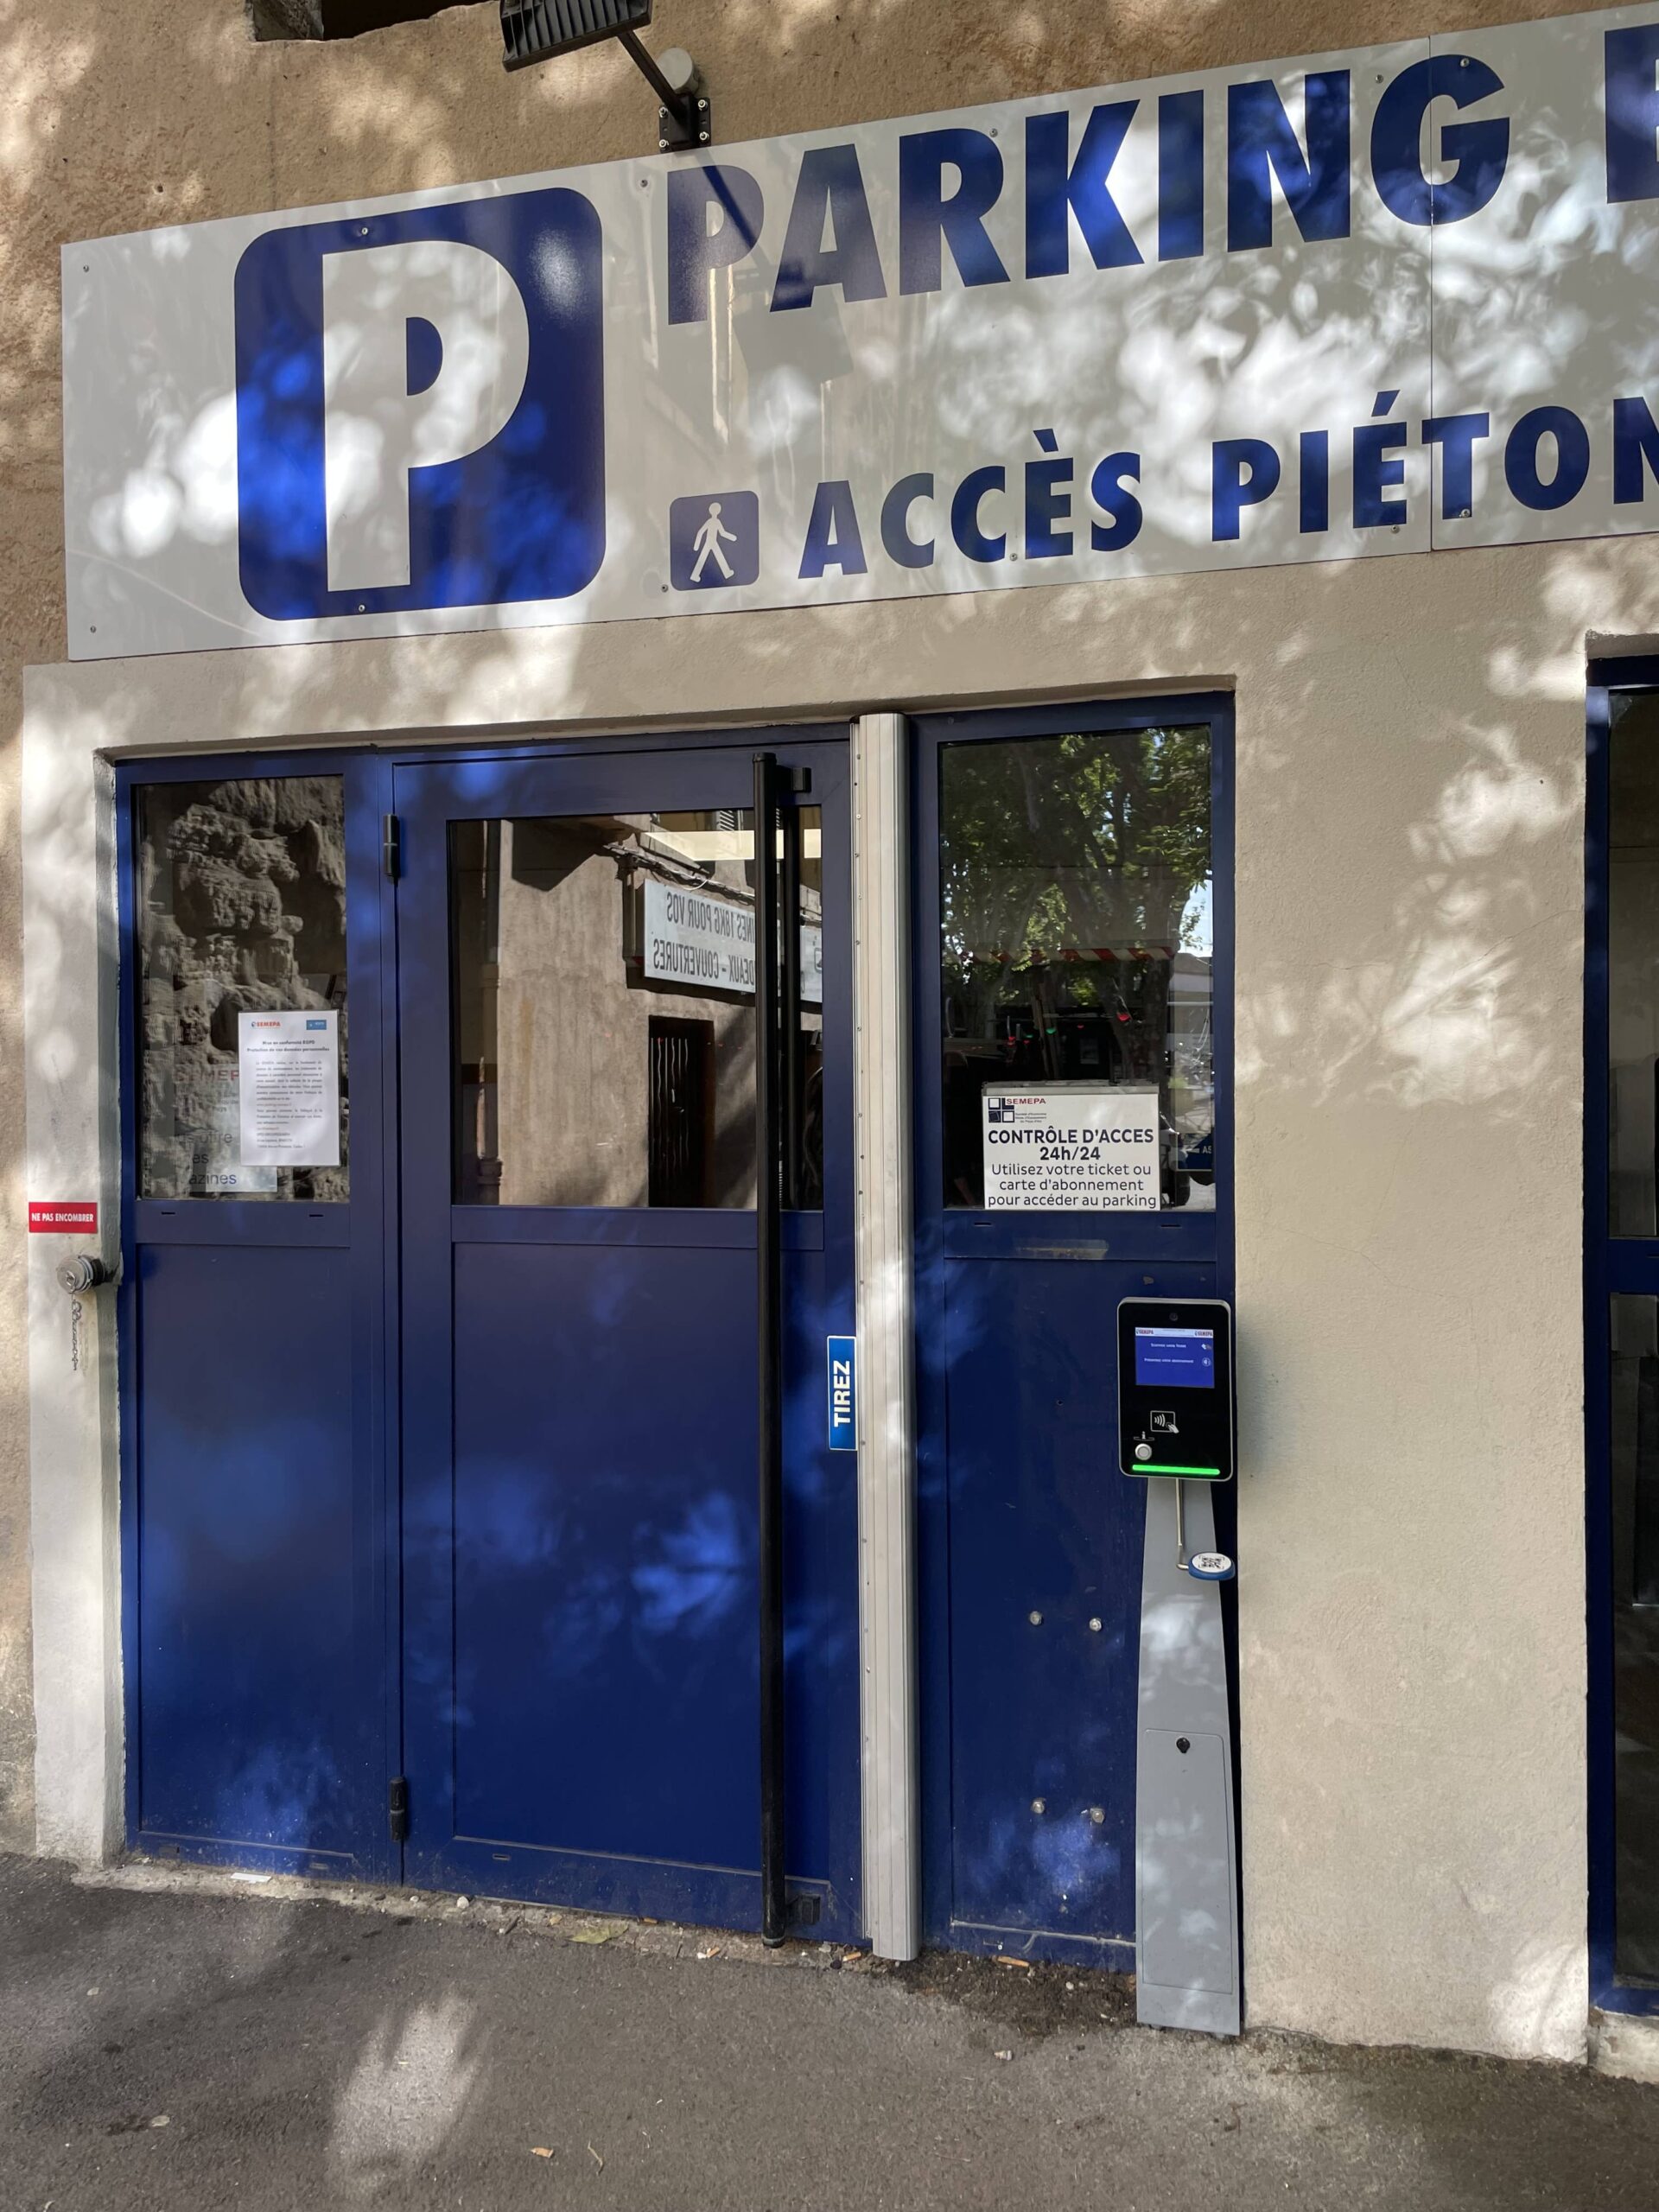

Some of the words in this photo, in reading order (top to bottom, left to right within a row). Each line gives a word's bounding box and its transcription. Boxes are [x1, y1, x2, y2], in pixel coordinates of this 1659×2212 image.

[667, 54, 1510, 325] PARKING
[322, 240, 530, 592] P
[798, 429, 1142, 579] ACCÈS
[988, 1125, 1077, 1144] CONTRÔLE
[1082, 1128, 1154, 1143] D'ACCES
[1039, 1146, 1101, 1161] 24h/24
[992, 1163, 1043, 1175] Utilisez
[1046, 1165, 1084, 1175] votre
[1088, 1163, 1129, 1175] ticket
[1133, 1166, 1151, 1175] ou
[999, 1180, 1036, 1191] carte
[1039, 1179, 1144, 1191] d'abonnement
[988, 1196, 1020, 1208] pour
[1023, 1193, 1078, 1205] accéder
[1081, 1196, 1098, 1205] au
[1103, 1194, 1156, 1209] parking
[31, 1212, 41, 1222] NE
[41, 1212, 54, 1222] PAS
[54, 1213, 94, 1223] ENCOMBRER
[833, 1360, 851, 1427] TIREZ
